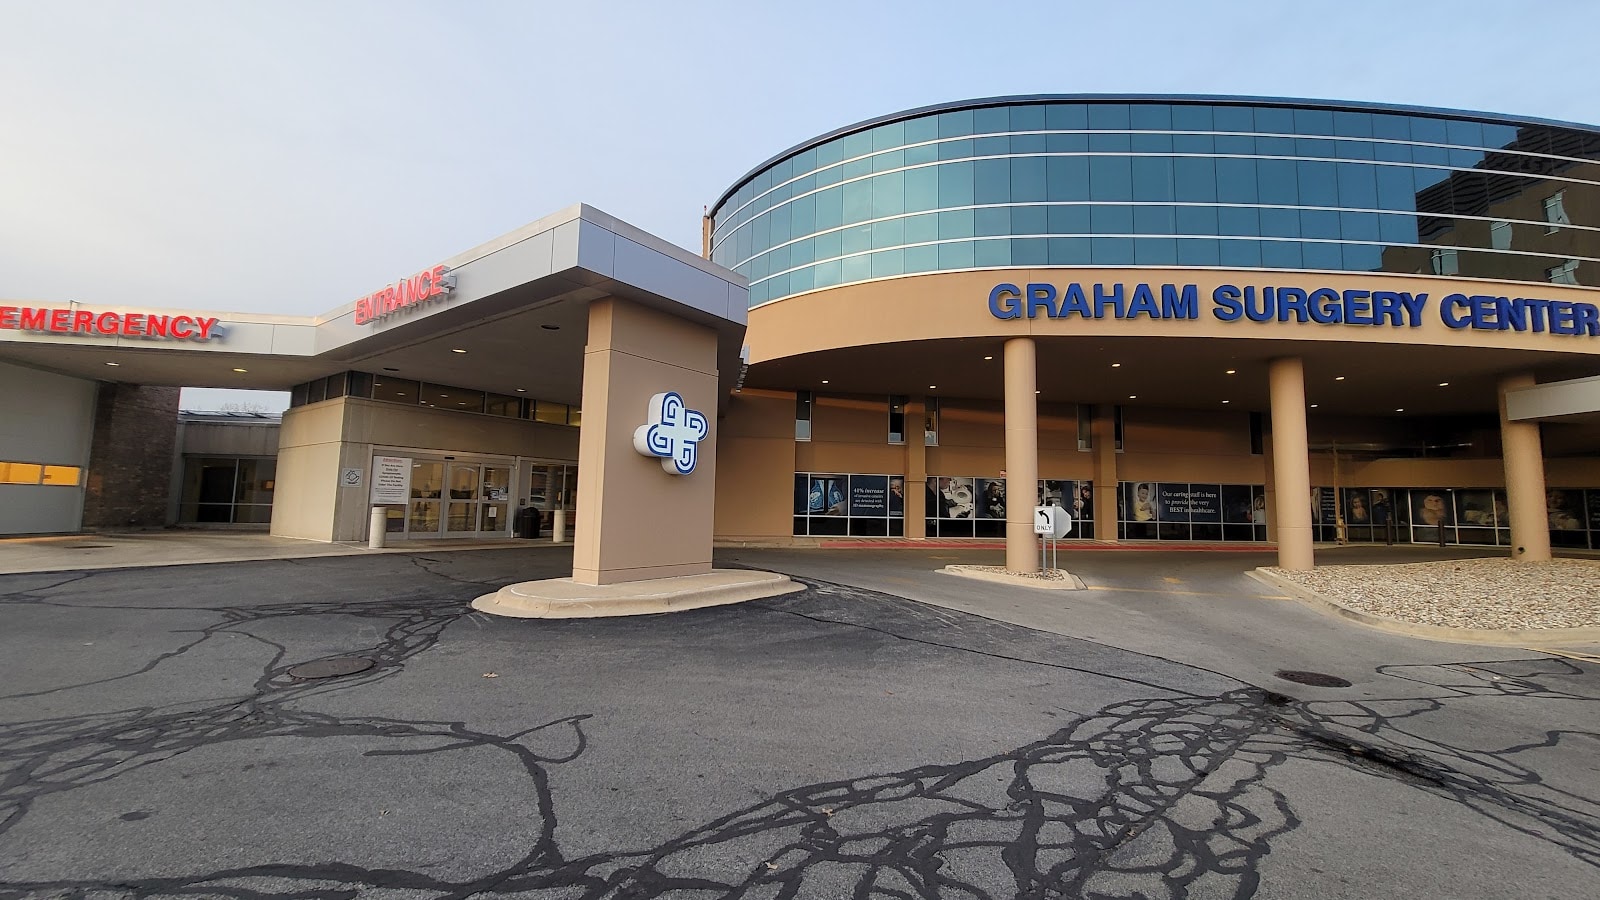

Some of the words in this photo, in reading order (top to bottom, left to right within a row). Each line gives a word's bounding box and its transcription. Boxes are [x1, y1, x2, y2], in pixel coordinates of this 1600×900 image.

[355, 264, 445, 326] ENTRANCE
[988, 283, 1199, 320] GRAHAM
[1212, 284, 1428, 328] SURGERY
[1440, 293, 1600, 337] CENTER
[0, 306, 217, 339] EMERGENCY
